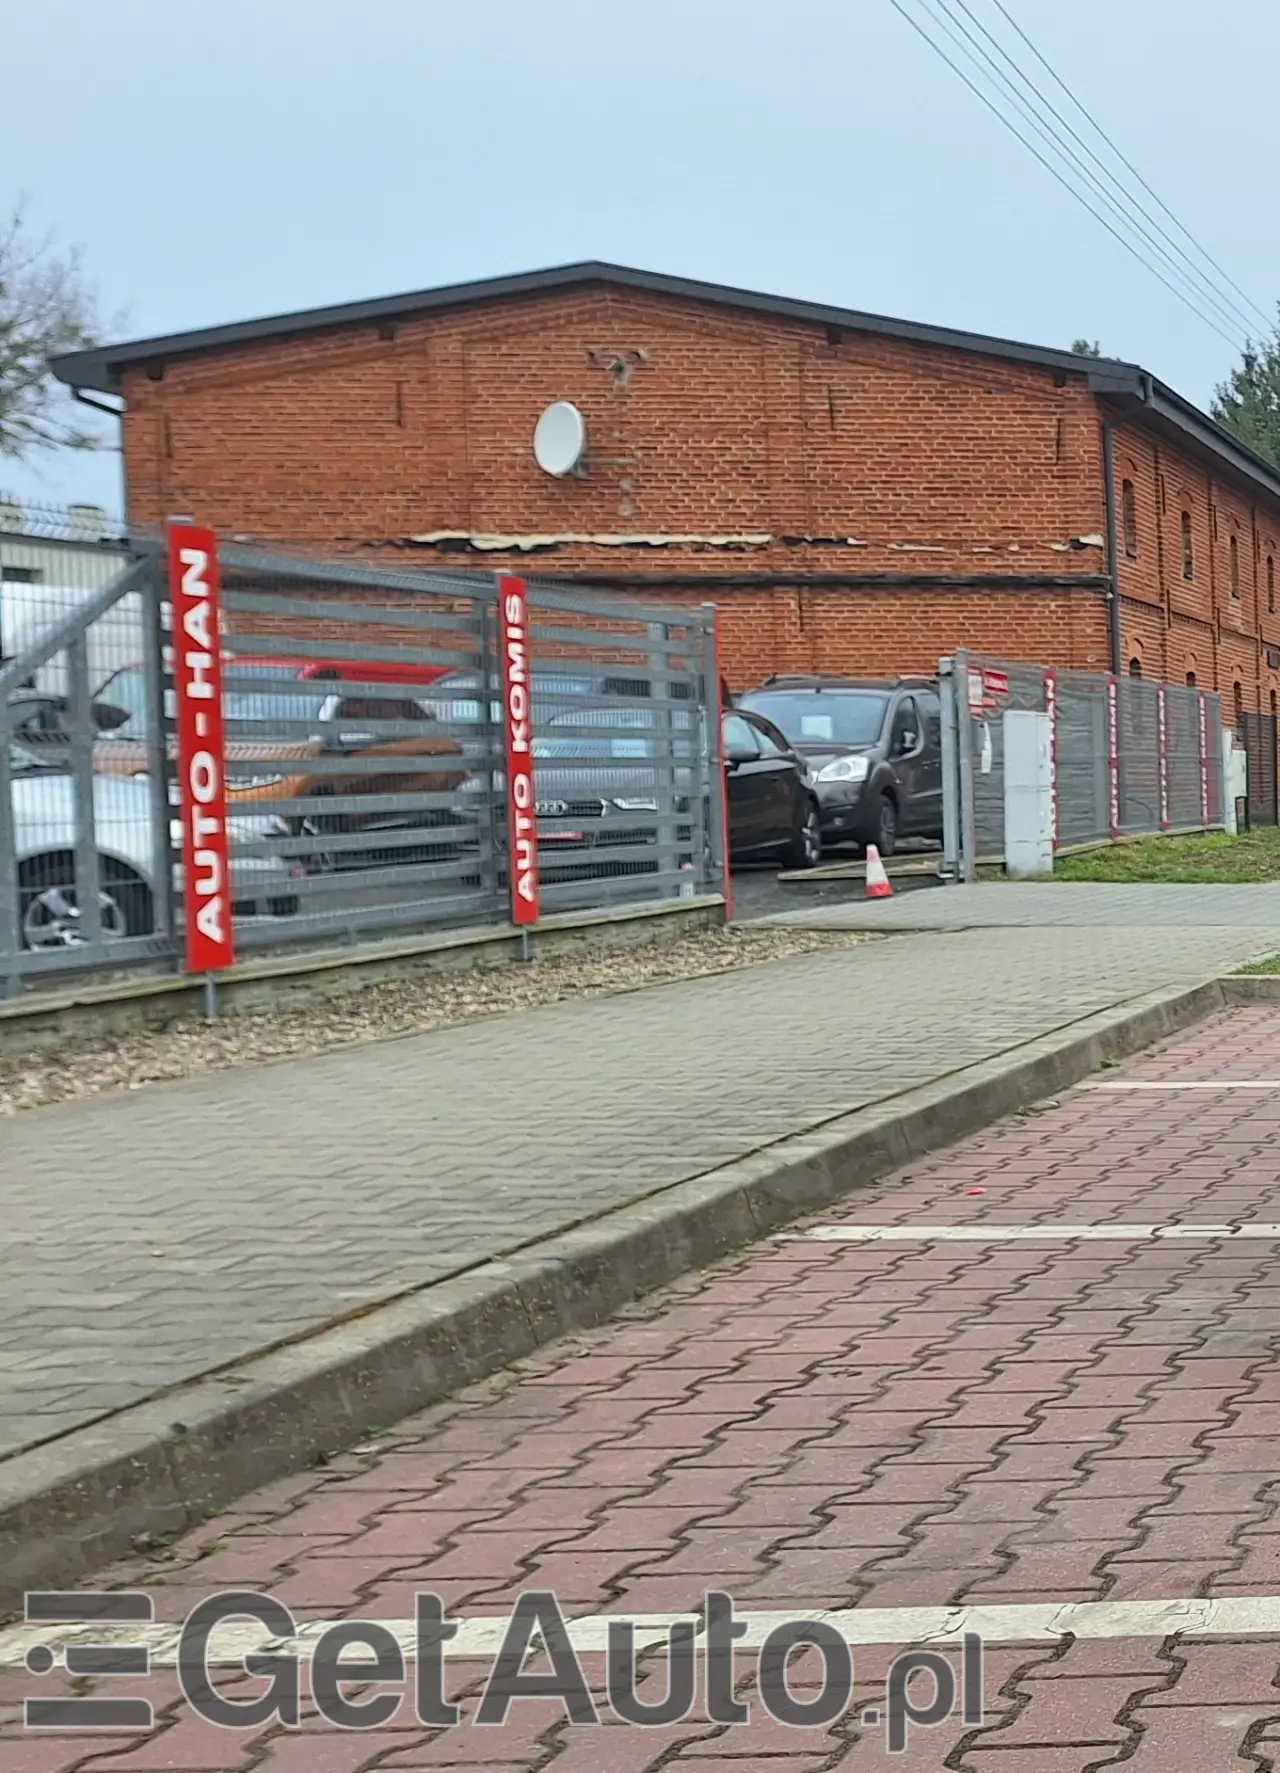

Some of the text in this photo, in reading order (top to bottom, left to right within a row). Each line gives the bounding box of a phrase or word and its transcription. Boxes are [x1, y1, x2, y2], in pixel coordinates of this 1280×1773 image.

[179, 547, 214, 699] HAN
[504, 593, 536, 903] AUTO KOMIS
[190, 750, 225, 945] AUTO
